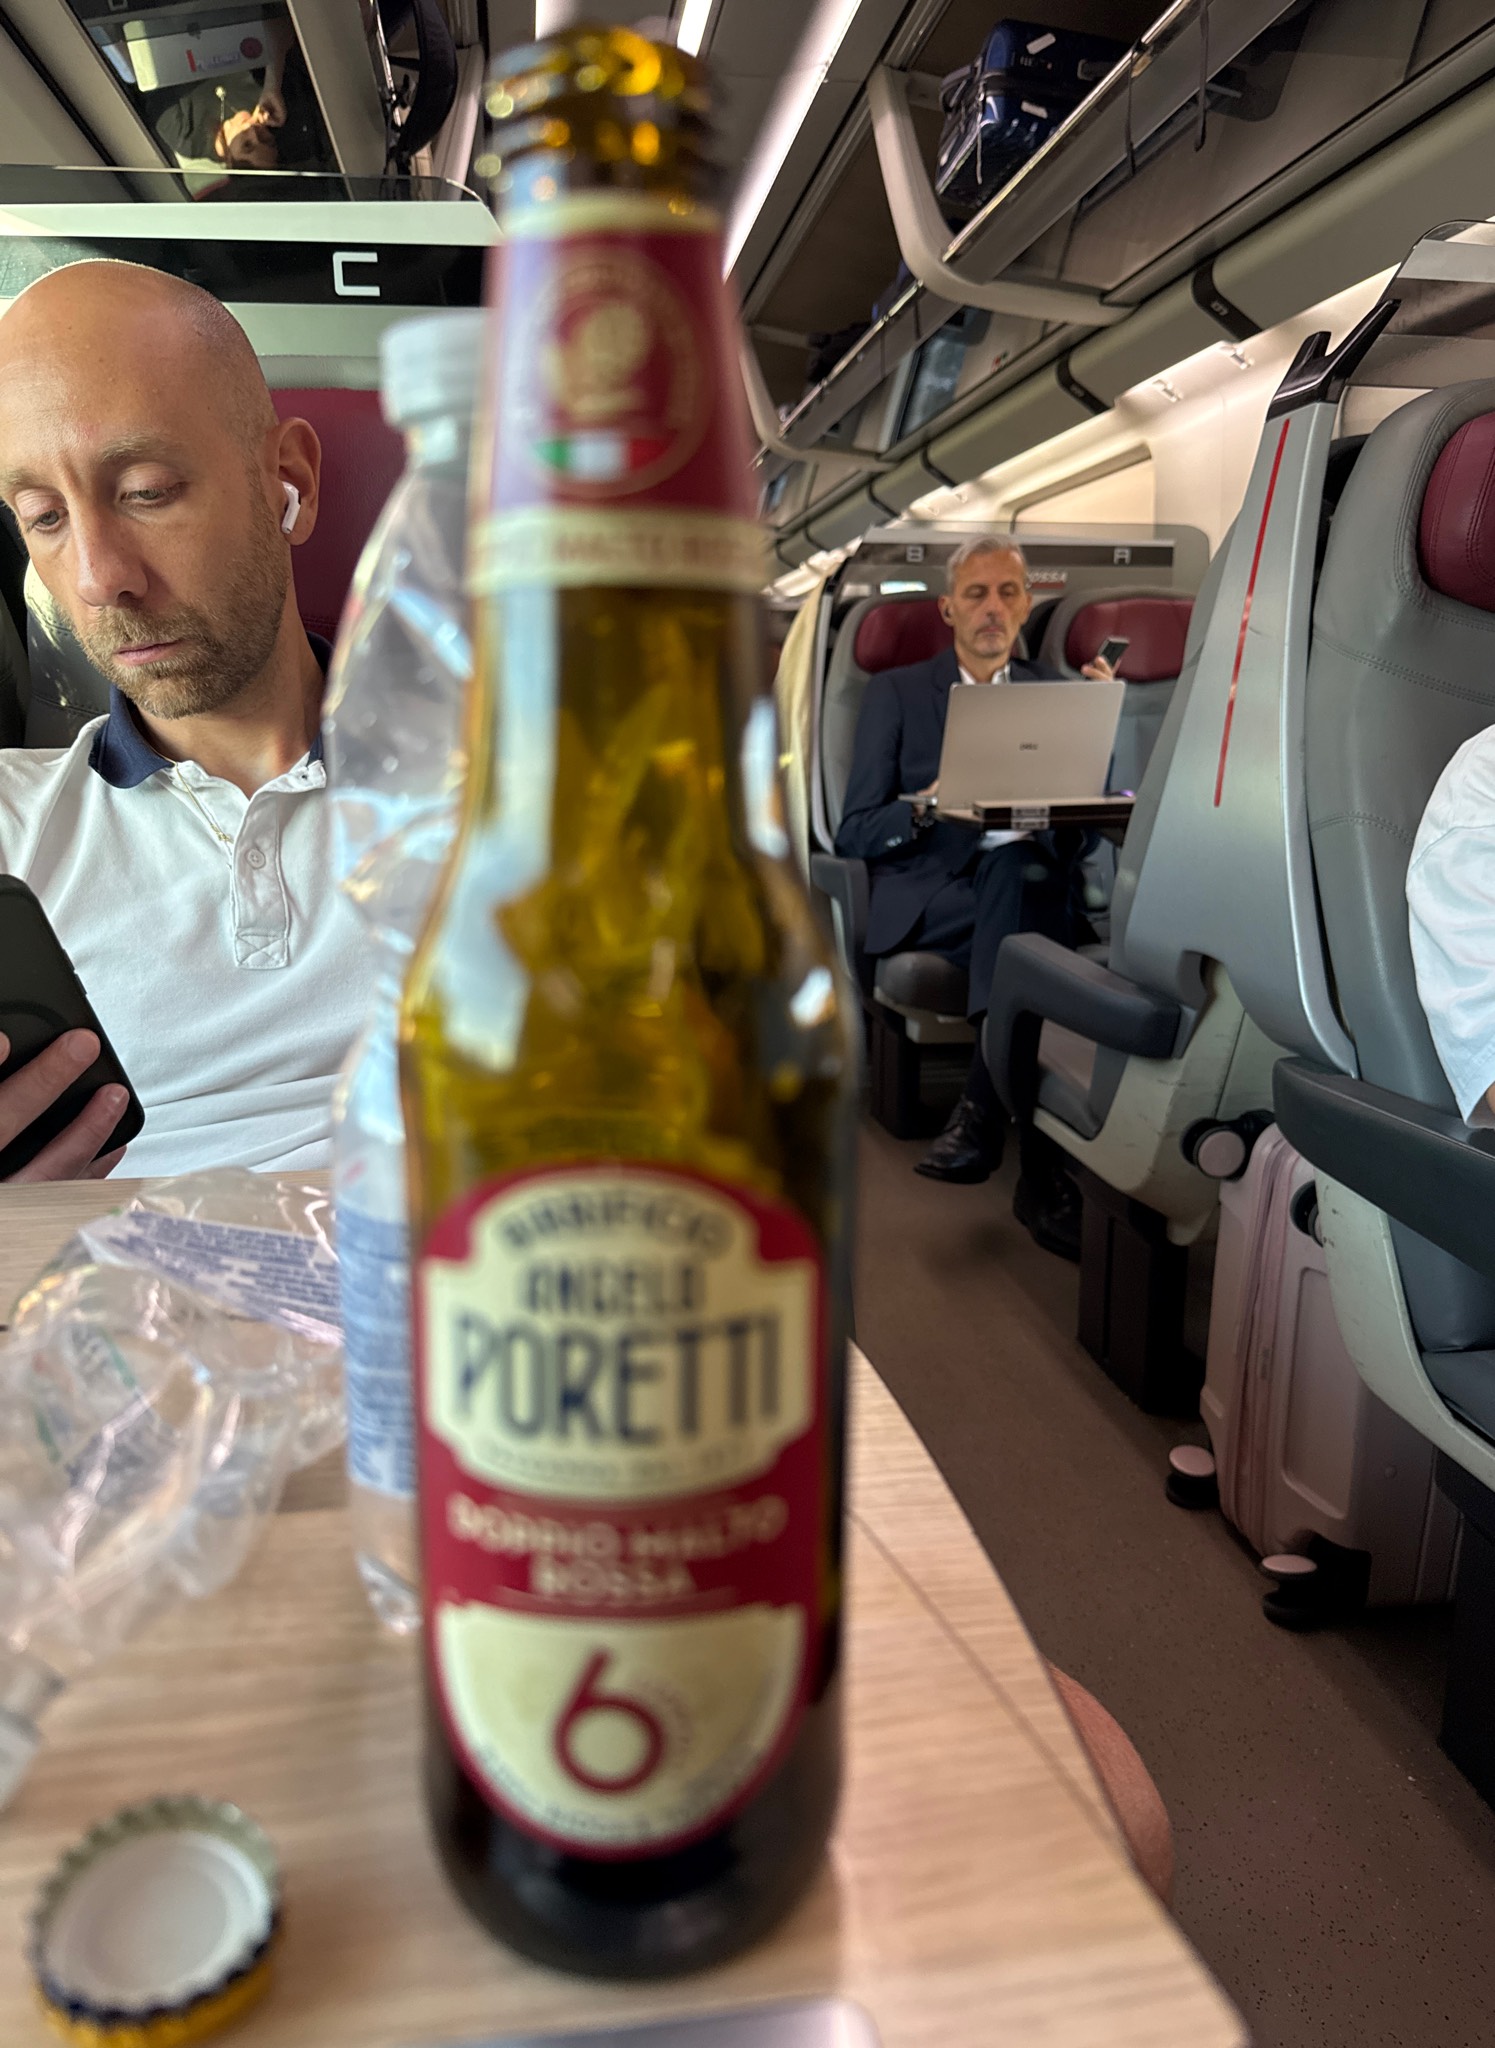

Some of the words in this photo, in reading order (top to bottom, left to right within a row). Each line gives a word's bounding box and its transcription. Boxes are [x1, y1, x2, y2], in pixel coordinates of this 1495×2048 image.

[333, 252, 380, 297] C
[1113, 548, 1131, 564] A
[453, 1305, 781, 1447] PORETTI
[551, 1642, 668, 1795] 6
